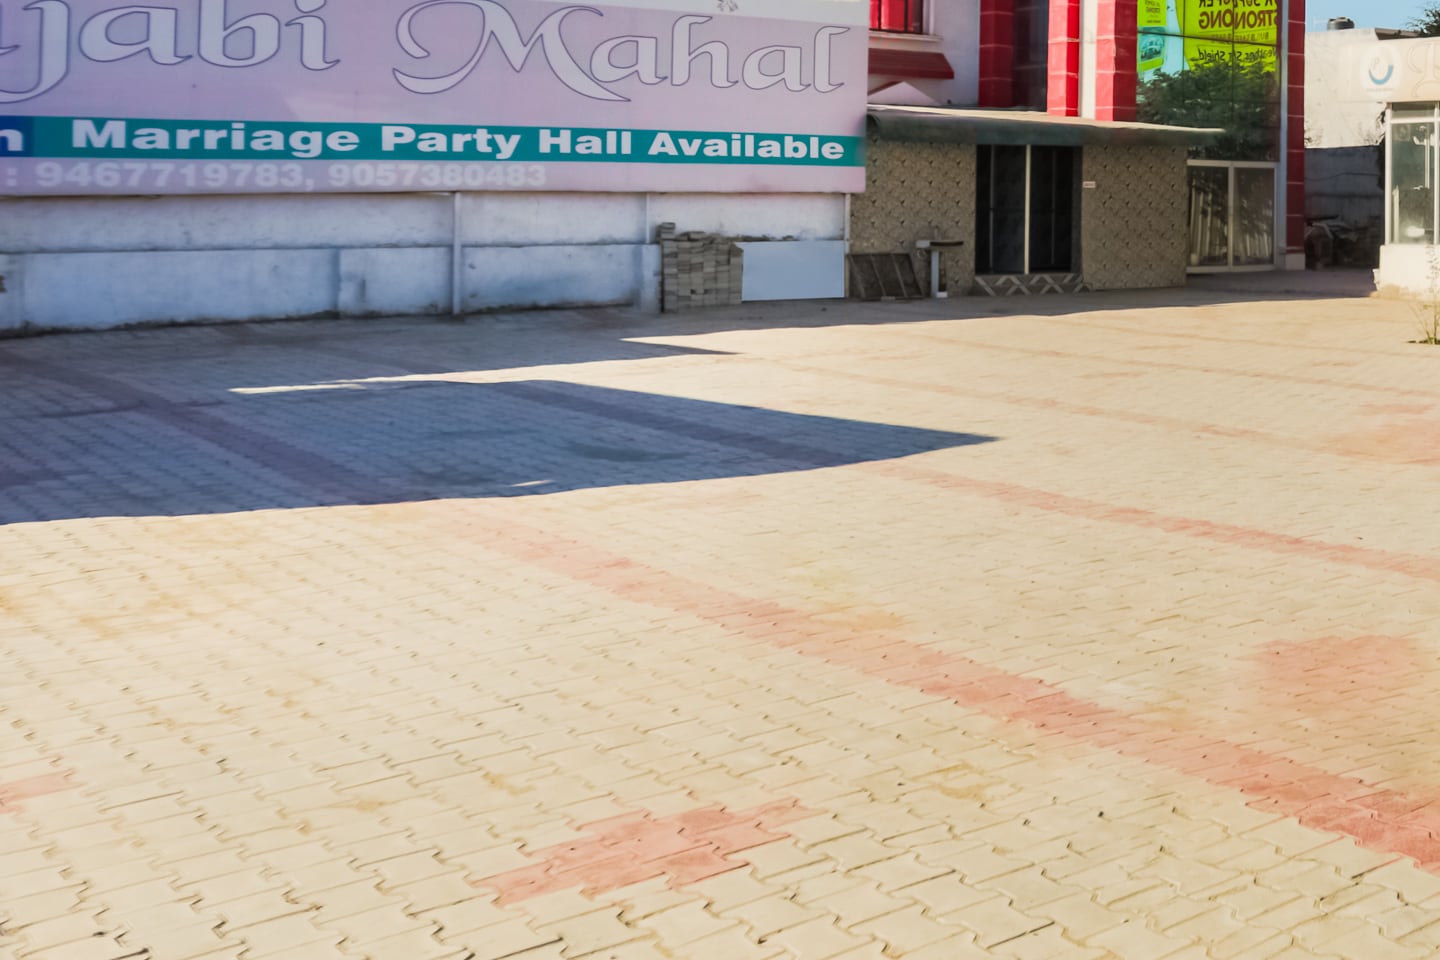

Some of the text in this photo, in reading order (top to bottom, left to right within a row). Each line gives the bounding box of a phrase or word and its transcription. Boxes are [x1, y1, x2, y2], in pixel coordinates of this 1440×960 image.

[72, 119, 360, 159] Marriage
[382, 126, 522, 159] Party
[538, 129, 631, 155] Hall
[648, 132, 844, 159] Available
